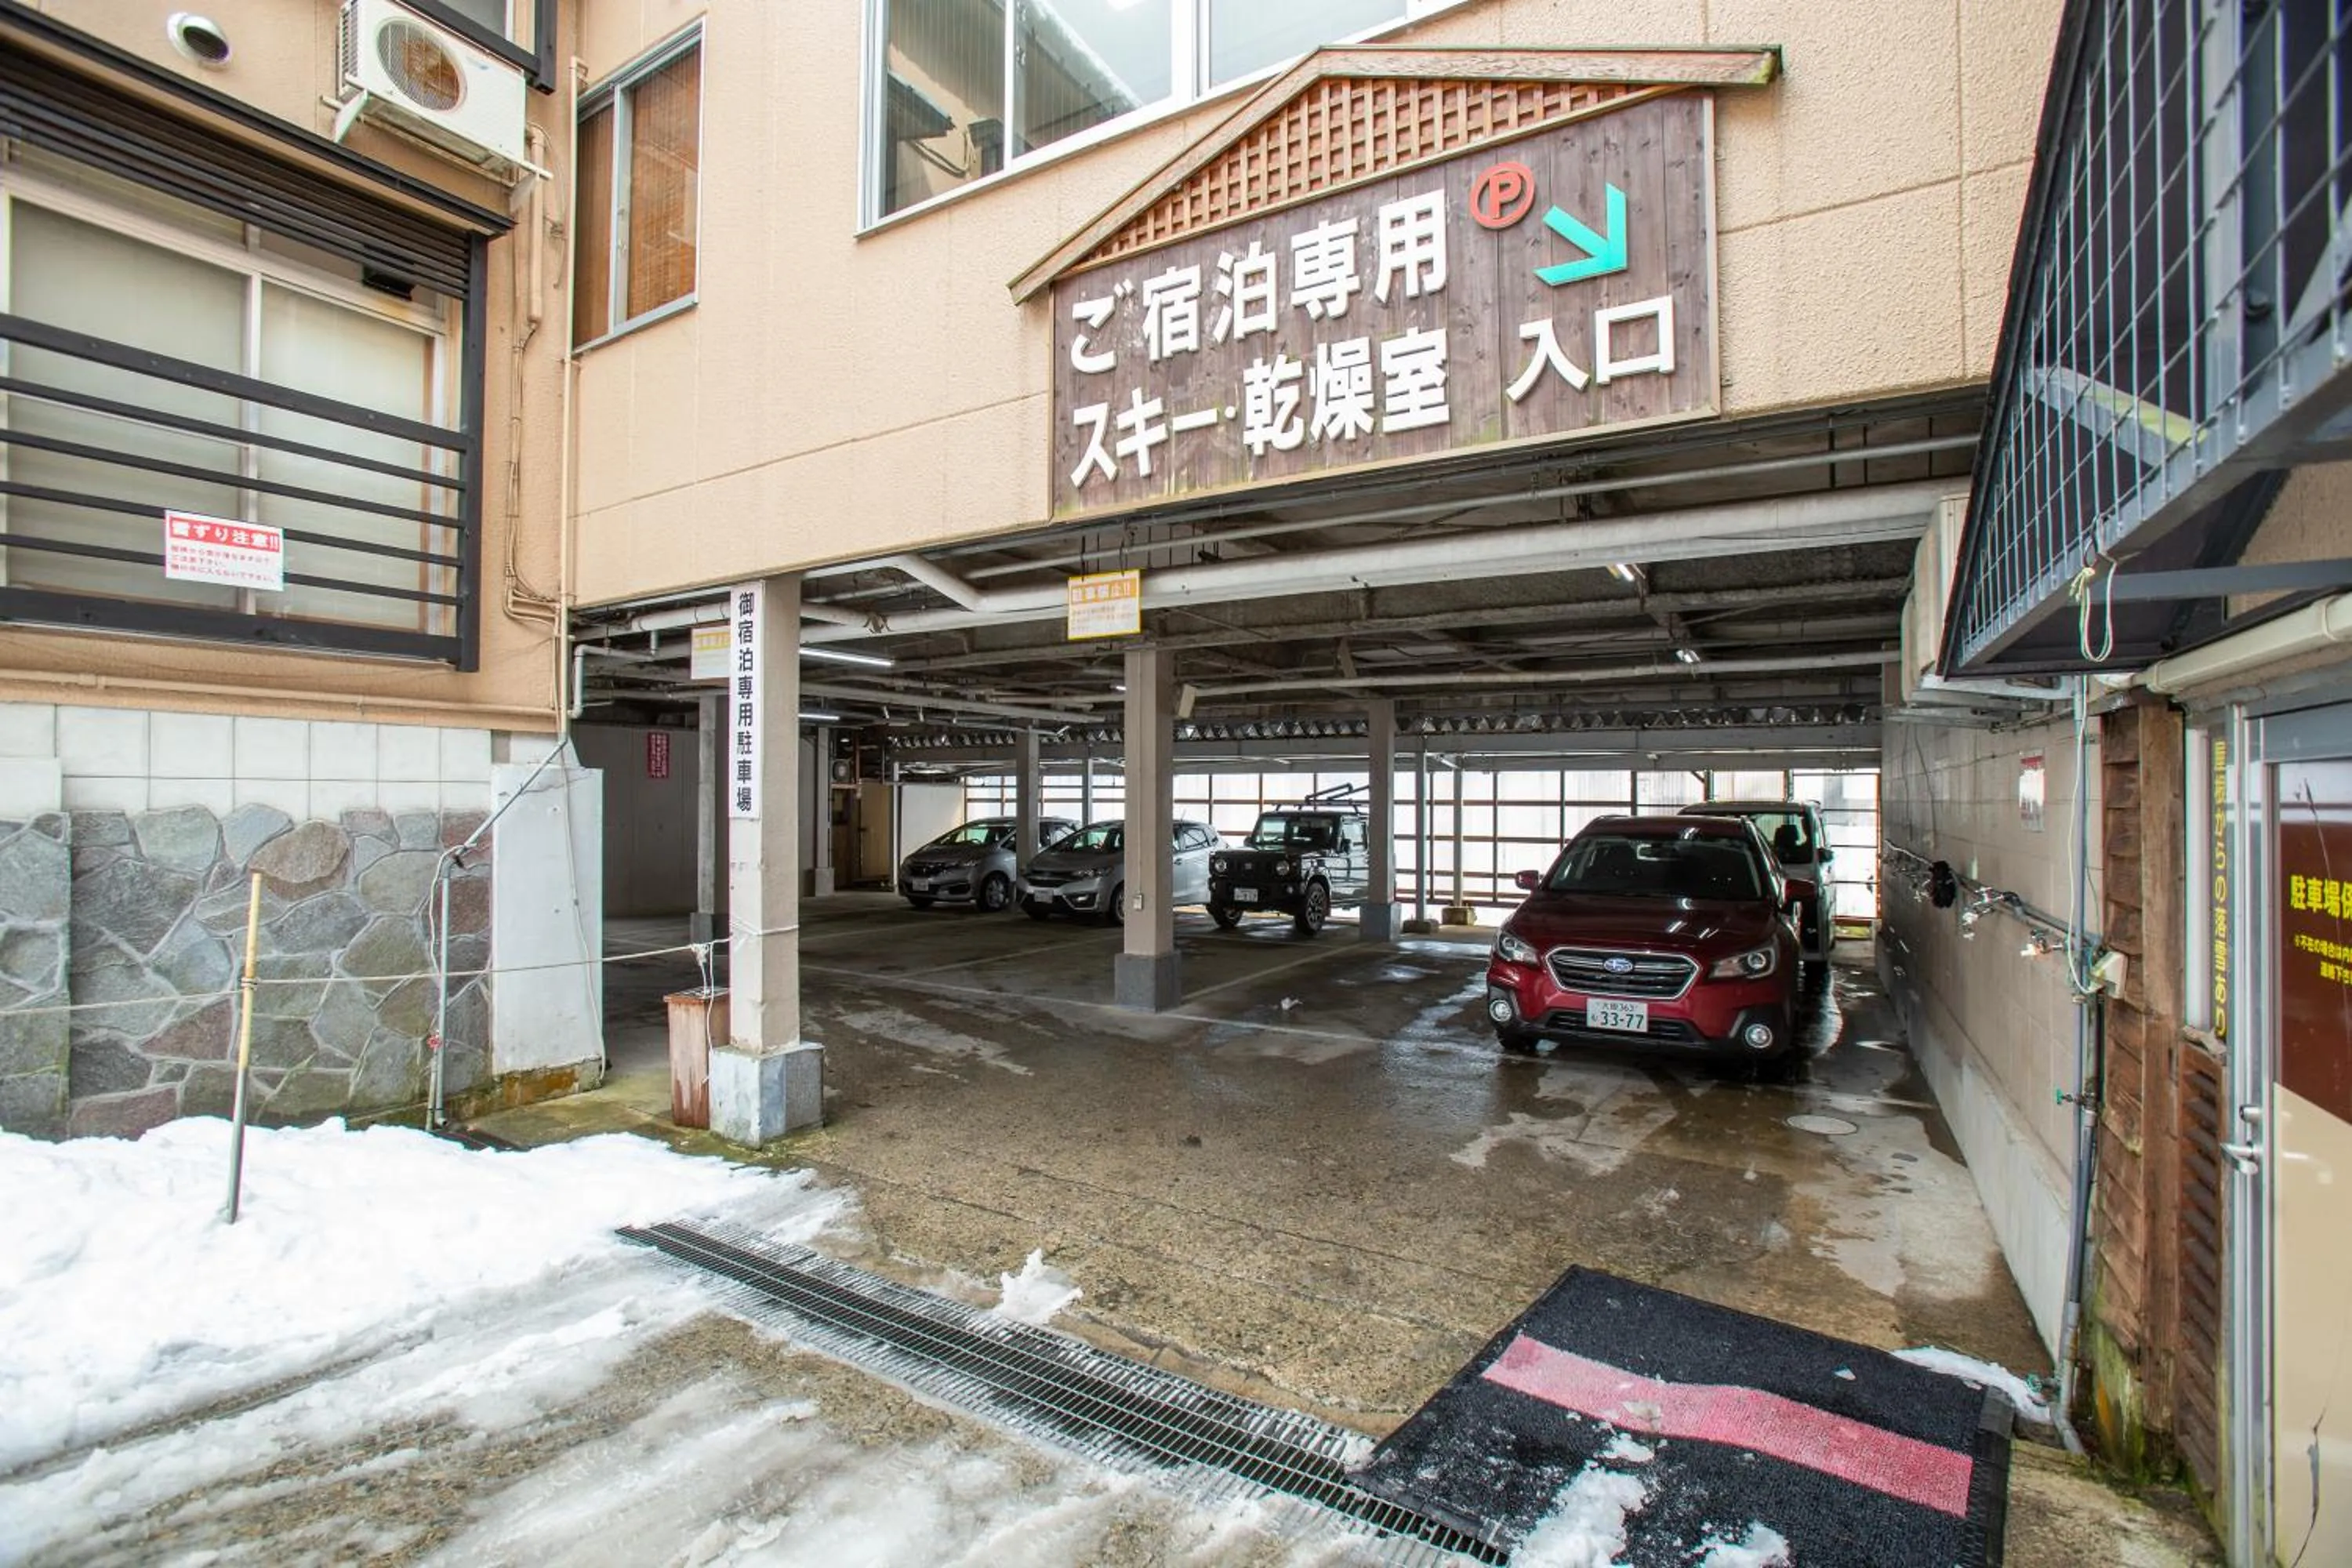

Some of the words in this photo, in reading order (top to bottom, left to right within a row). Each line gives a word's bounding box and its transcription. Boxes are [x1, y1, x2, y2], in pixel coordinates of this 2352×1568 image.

[1069, 188, 1449, 375] ご宿泊専用
[1505, 294, 1676, 403] 入口
[736, 592, 755, 812] 御宿泊専用駐車場
[1600, 1011, 1645, 1029] 33-77
